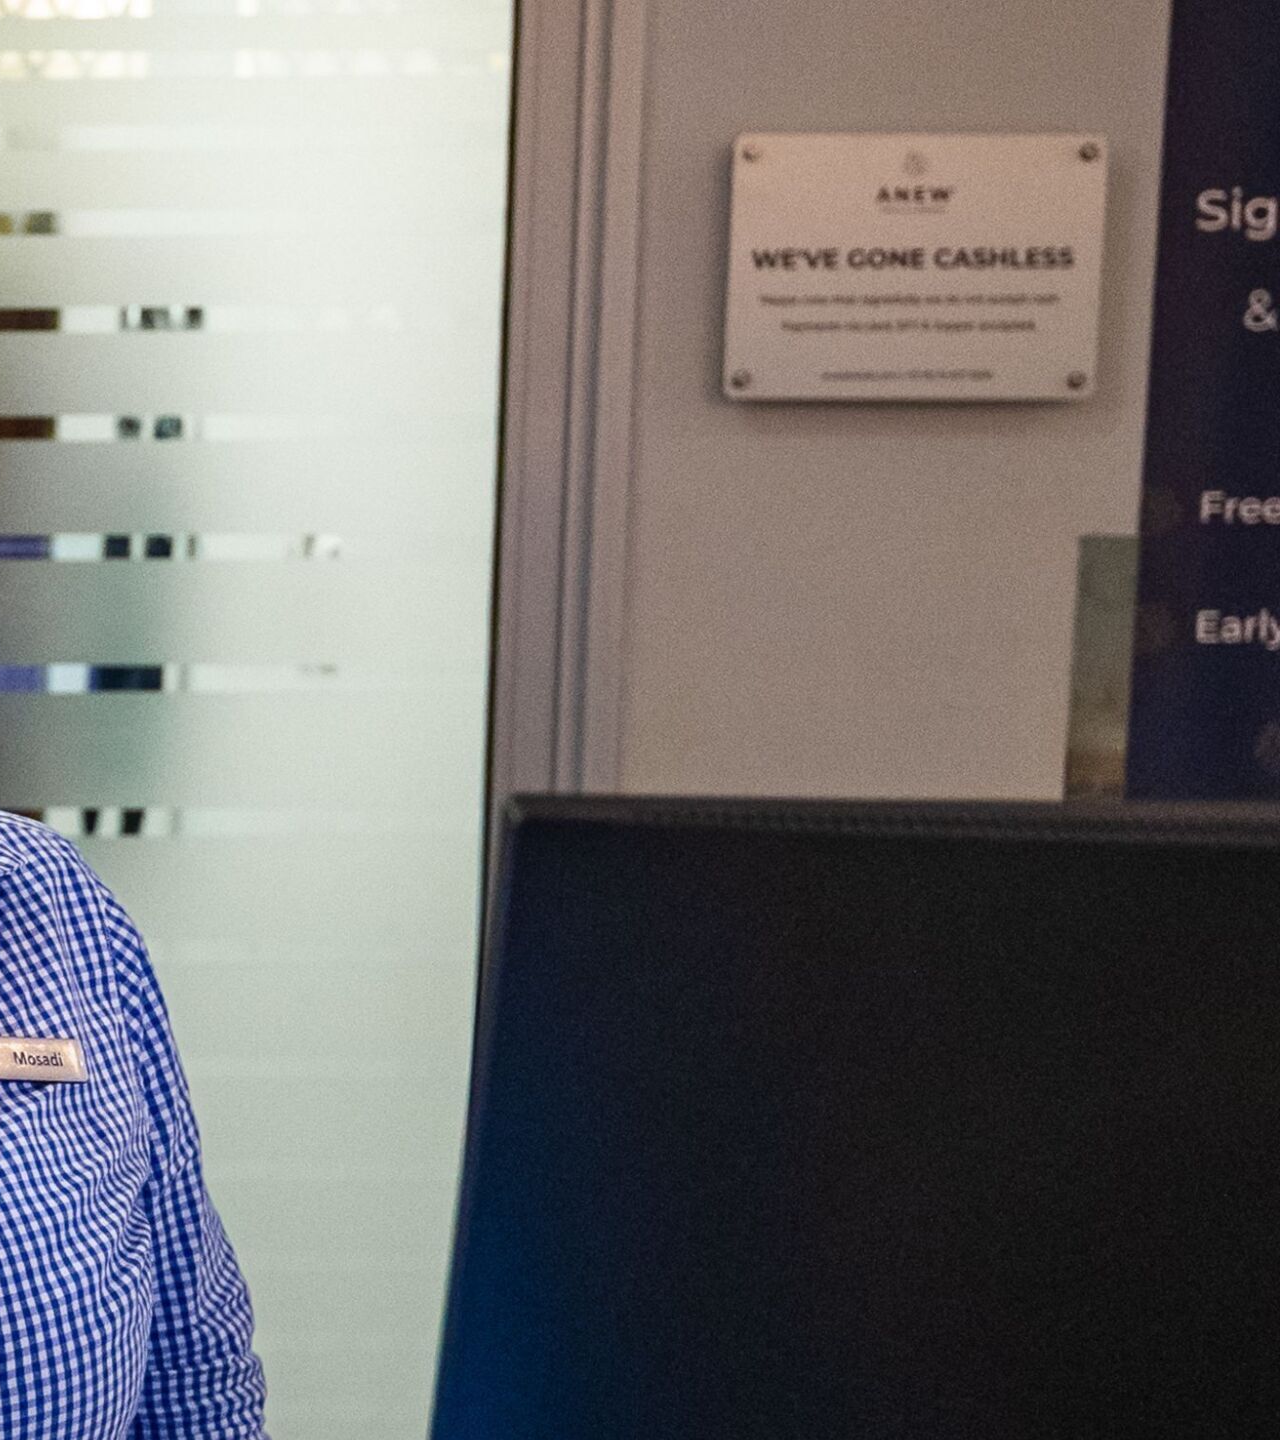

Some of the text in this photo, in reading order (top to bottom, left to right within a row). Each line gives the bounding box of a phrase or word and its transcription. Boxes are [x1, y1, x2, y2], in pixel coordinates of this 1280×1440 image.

[876, 185, 955, 202] ANEW
[751, 247, 1075, 270] WE'VE GONE CASHLESS
[1243, 288, 1278, 332] &
[1199, 489, 1280, 524] Free
[12, 1051, 64, 1067] Mosadi
